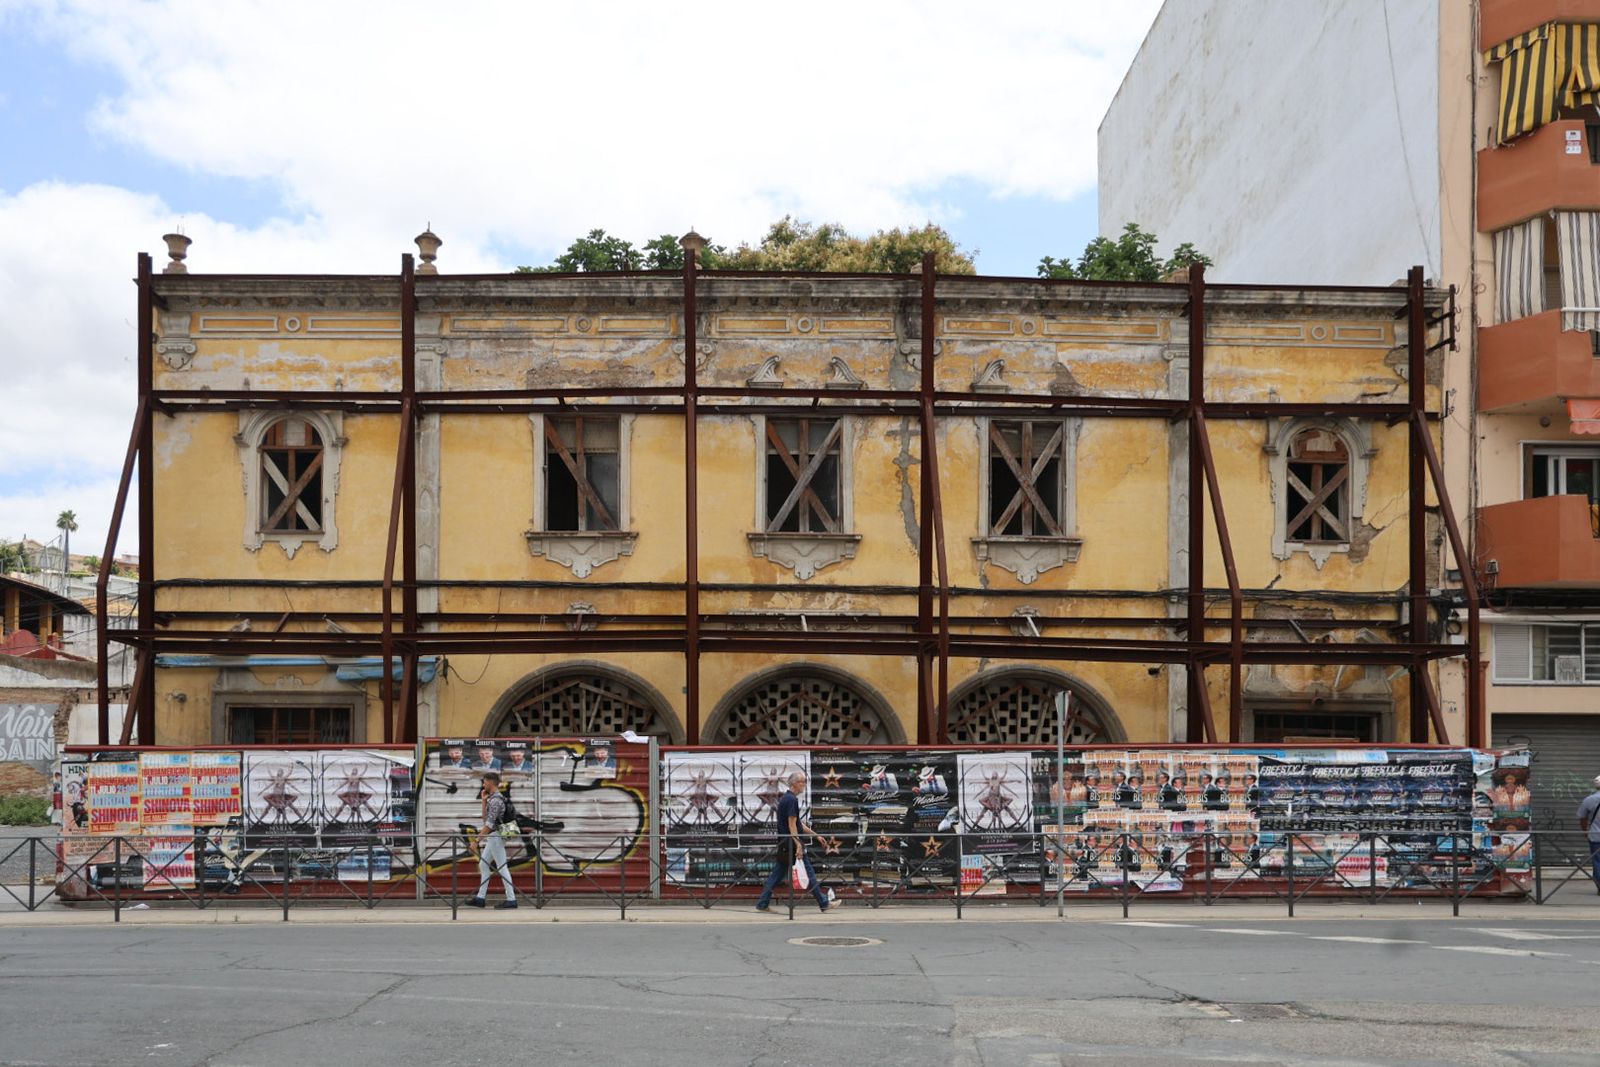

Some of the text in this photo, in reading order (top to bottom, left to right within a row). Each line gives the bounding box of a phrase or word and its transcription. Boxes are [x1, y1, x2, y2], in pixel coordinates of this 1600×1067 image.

[1090, 792, 1100, 801] BIS
[1111, 791, 1121, 800] BIS
[1133, 792, 1143, 802] BIS
[1153, 793, 1165, 802] BIS
[1177, 795, 1188, 803] BIS
[1197, 794, 1208, 803] BIS
[1221, 794, 1231, 803] BIS
[1240, 794, 1251, 803] BIS
[143, 798, 191, 813] SHINOVA
[193, 798, 240, 813] SHINOVA
[91, 808, 138, 823] SHINOVA
[1110, 852, 1121, 861] BIS
